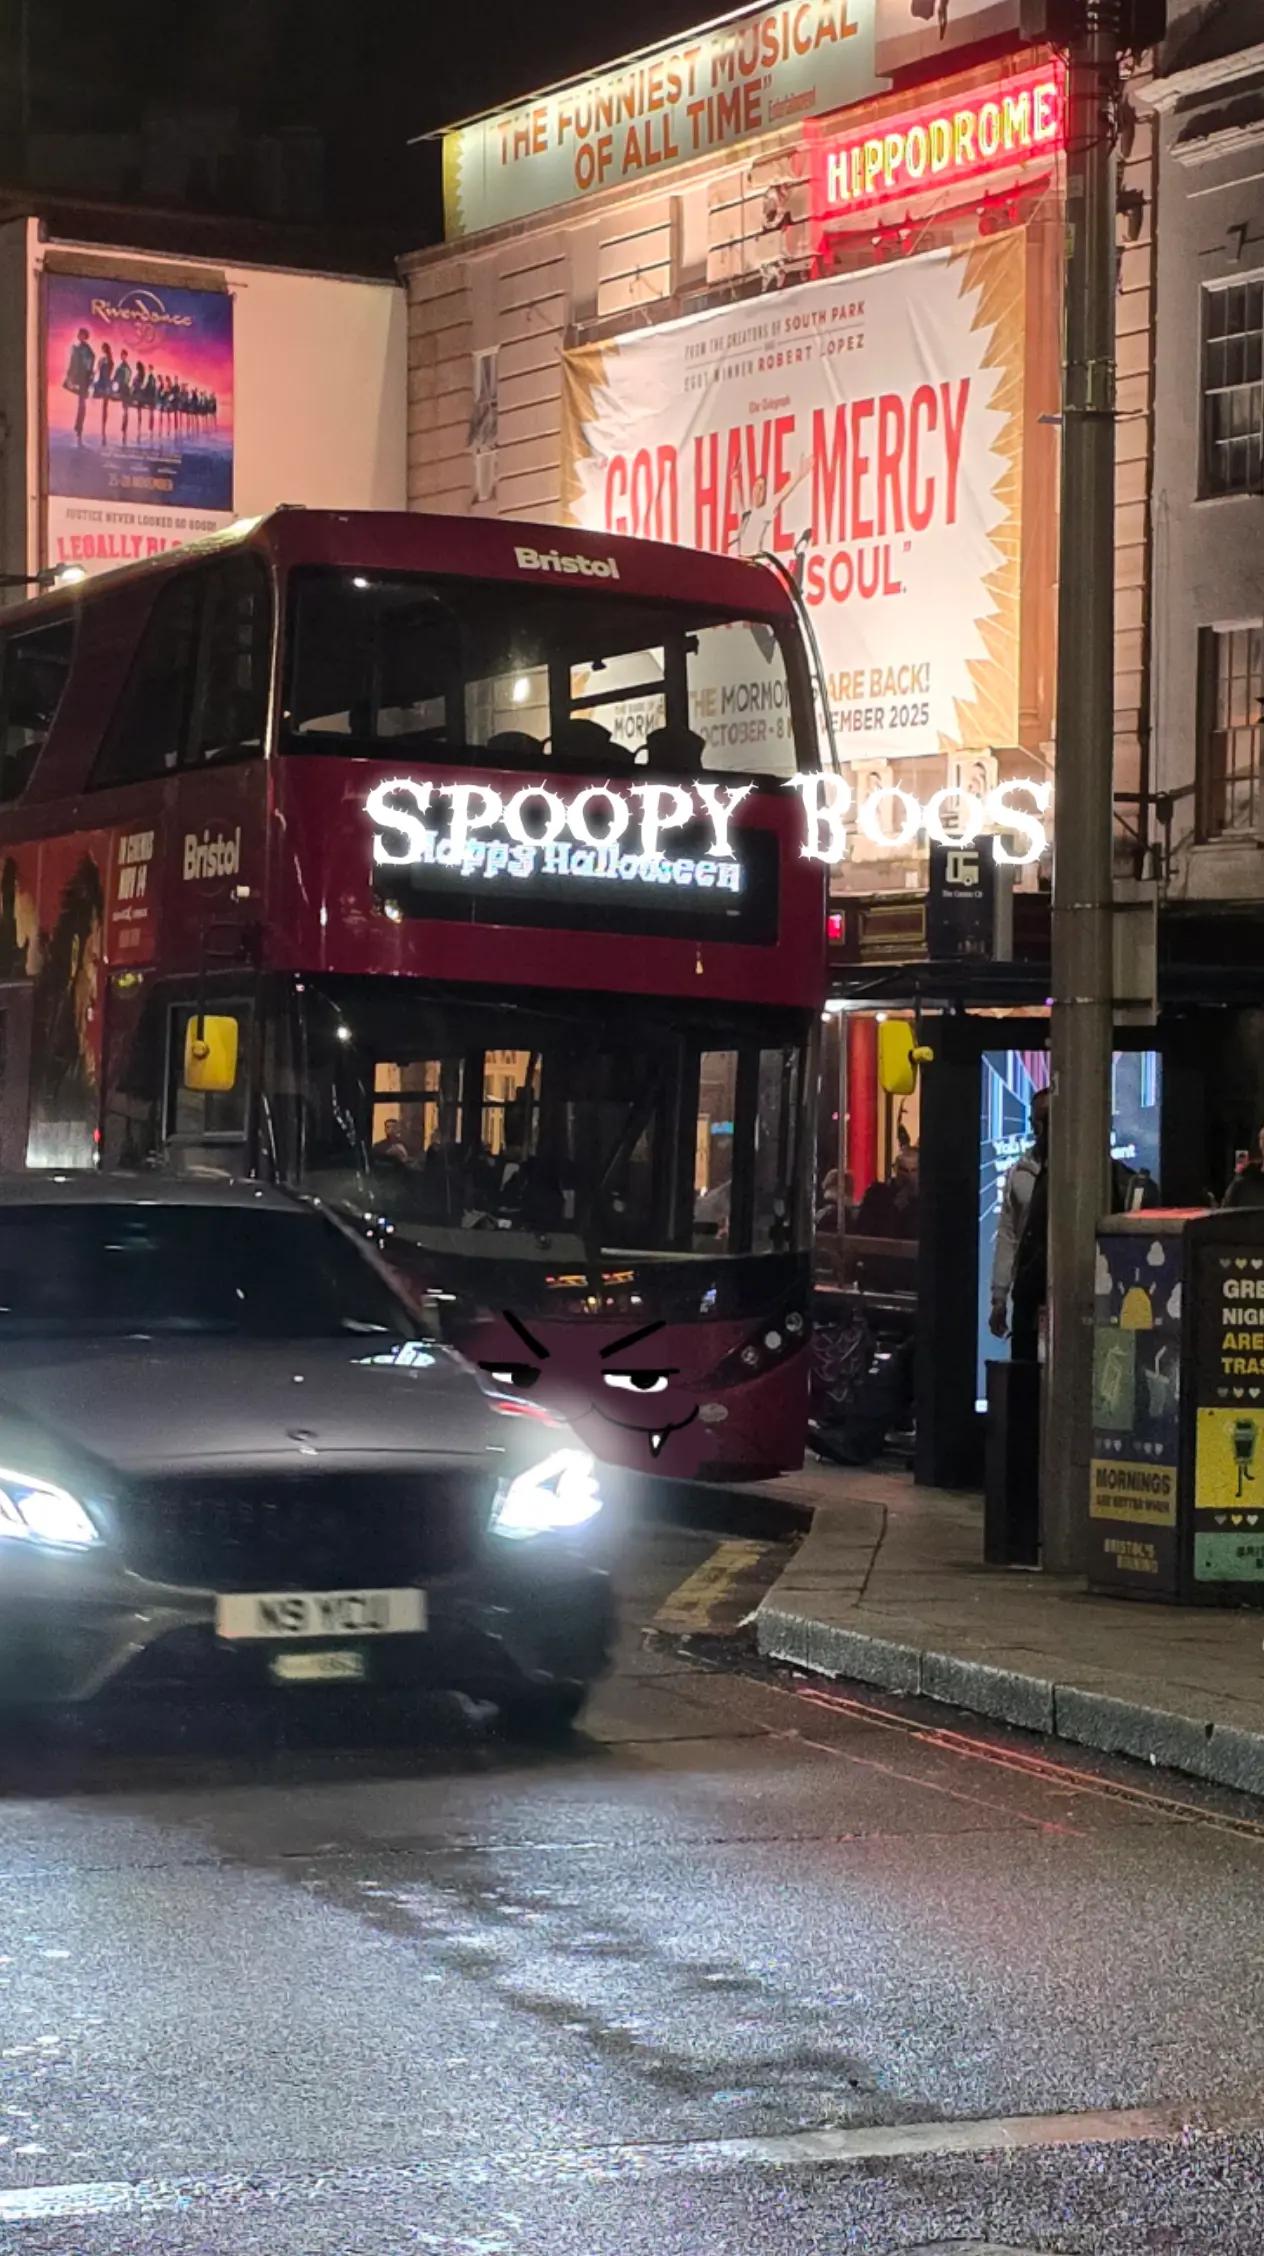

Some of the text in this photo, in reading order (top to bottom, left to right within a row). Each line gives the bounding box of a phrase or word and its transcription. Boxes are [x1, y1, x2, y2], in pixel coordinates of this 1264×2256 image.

[557, 46, 701, 146] FUNNIEST
[711, 0, 859, 88] MUSICAL
[575, 133, 613, 190] OF
[621, 113, 678, 175] ALL
[826, 82, 1058, 204] HIPPODROME
[784, 310, 827, 333] SOUTH
[831, 301, 865, 322] PARK
[757, 346, 812, 373] ROBERT
[819, 333, 865, 358] LOPEZ
[693, 414, 796, 556] HAVE
[810, 377, 971, 548] MERCY
[56, 533, 145, 562] LEGALLY
[513, 546, 620, 580] Bristol
[828, 669, 866, 702] ARE
[869, 661, 931, 699] BACK!
[888, 702, 930, 728] 2025
[183, 826, 242, 881] Bristol
[541, 841, 743, 893] Halloween
[1222, 1331, 1264, 1351] ARE
[1095, 1468, 1171, 1497] MORNINGS
